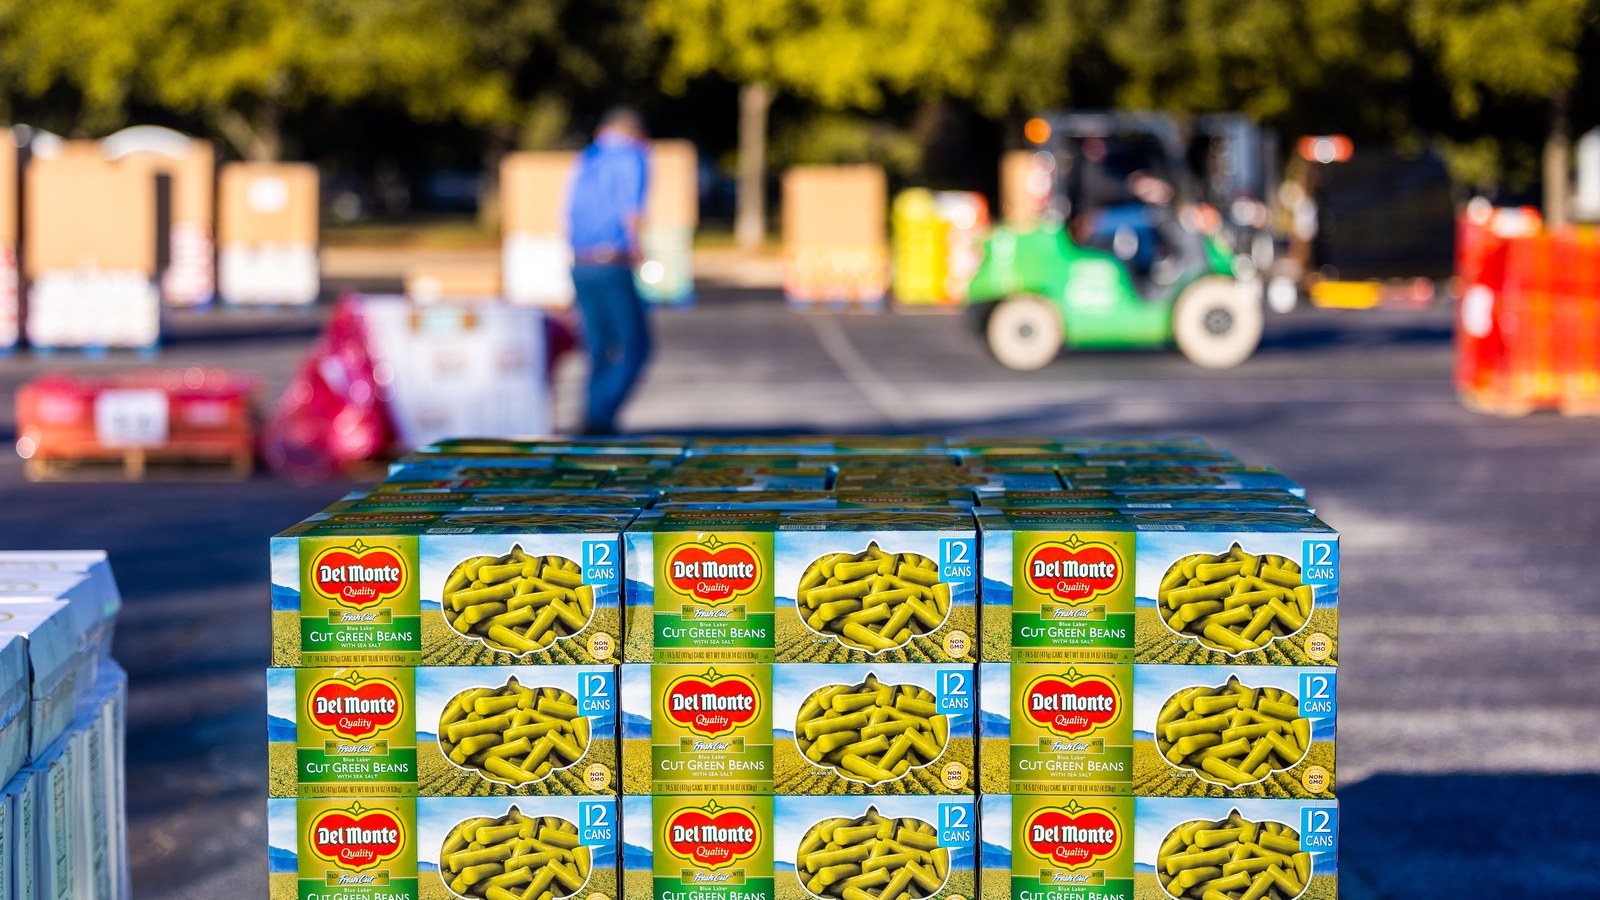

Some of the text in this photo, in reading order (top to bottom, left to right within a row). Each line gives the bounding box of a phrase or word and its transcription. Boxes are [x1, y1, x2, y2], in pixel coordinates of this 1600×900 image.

[589, 544, 612, 566] 12
[946, 541, 969, 564] 12
[1309, 544, 1333, 566] 12
[320, 565, 400, 583] Del Monte
[588, 568, 614, 579] CANS
[674, 561, 754, 579] Del Monte
[944, 566, 971, 577] CANS
[1034, 560, 1115, 579] Del Monte
[1307, 568, 1334, 579] CANS
[343, 586, 376, 598] Quality
[697, 582, 729, 594] Quality
[1057, 581, 1090, 593] Quality
[310, 630, 412, 642] CUT GREEN BEANS
[662, 627, 765, 638] CUT GREEN BEANS
[1021, 626, 1126, 638] CUT GREEN BEANS
[584, 675, 608, 697] 12
[943, 673, 967, 695] 12
[1306, 676, 1330, 698] 12
[316, 696, 396, 714] Del Monte
[583, 700, 610, 710] CANS
[672, 693, 753, 711] Del Monte
[942, 698, 969, 708] CANS
[1032, 693, 1114, 712] Del Monte
[1304, 702, 1331, 712] CANS
[340, 717, 372, 729] Quality
[696, 714, 728, 726] Quality
[1055, 714, 1088, 727] Quality
[306, 762, 408, 773] CUT GREEN BEANS
[661, 760, 764, 770] CUT GREEN BEANS
[1019, 760, 1124, 772] CUT GREEN BEANS
[586, 804, 609, 826] 12
[945, 806, 968, 828] 12
[1308, 810, 1331, 832] 12
[318, 826, 398, 845] Del Monte
[584, 829, 611, 840] CANS
[673, 825, 754, 843] Del Monte
[943, 830, 970, 841] CANS
[1033, 824, 1114, 845] Del Monte
[1306, 836, 1333, 846] CANS
[341, 848, 373, 860] Quality
[696, 846, 729, 858] Quality
[1056, 846, 1089, 859] Quality
[662, 891, 765, 900] CUT GREEN BEANS
